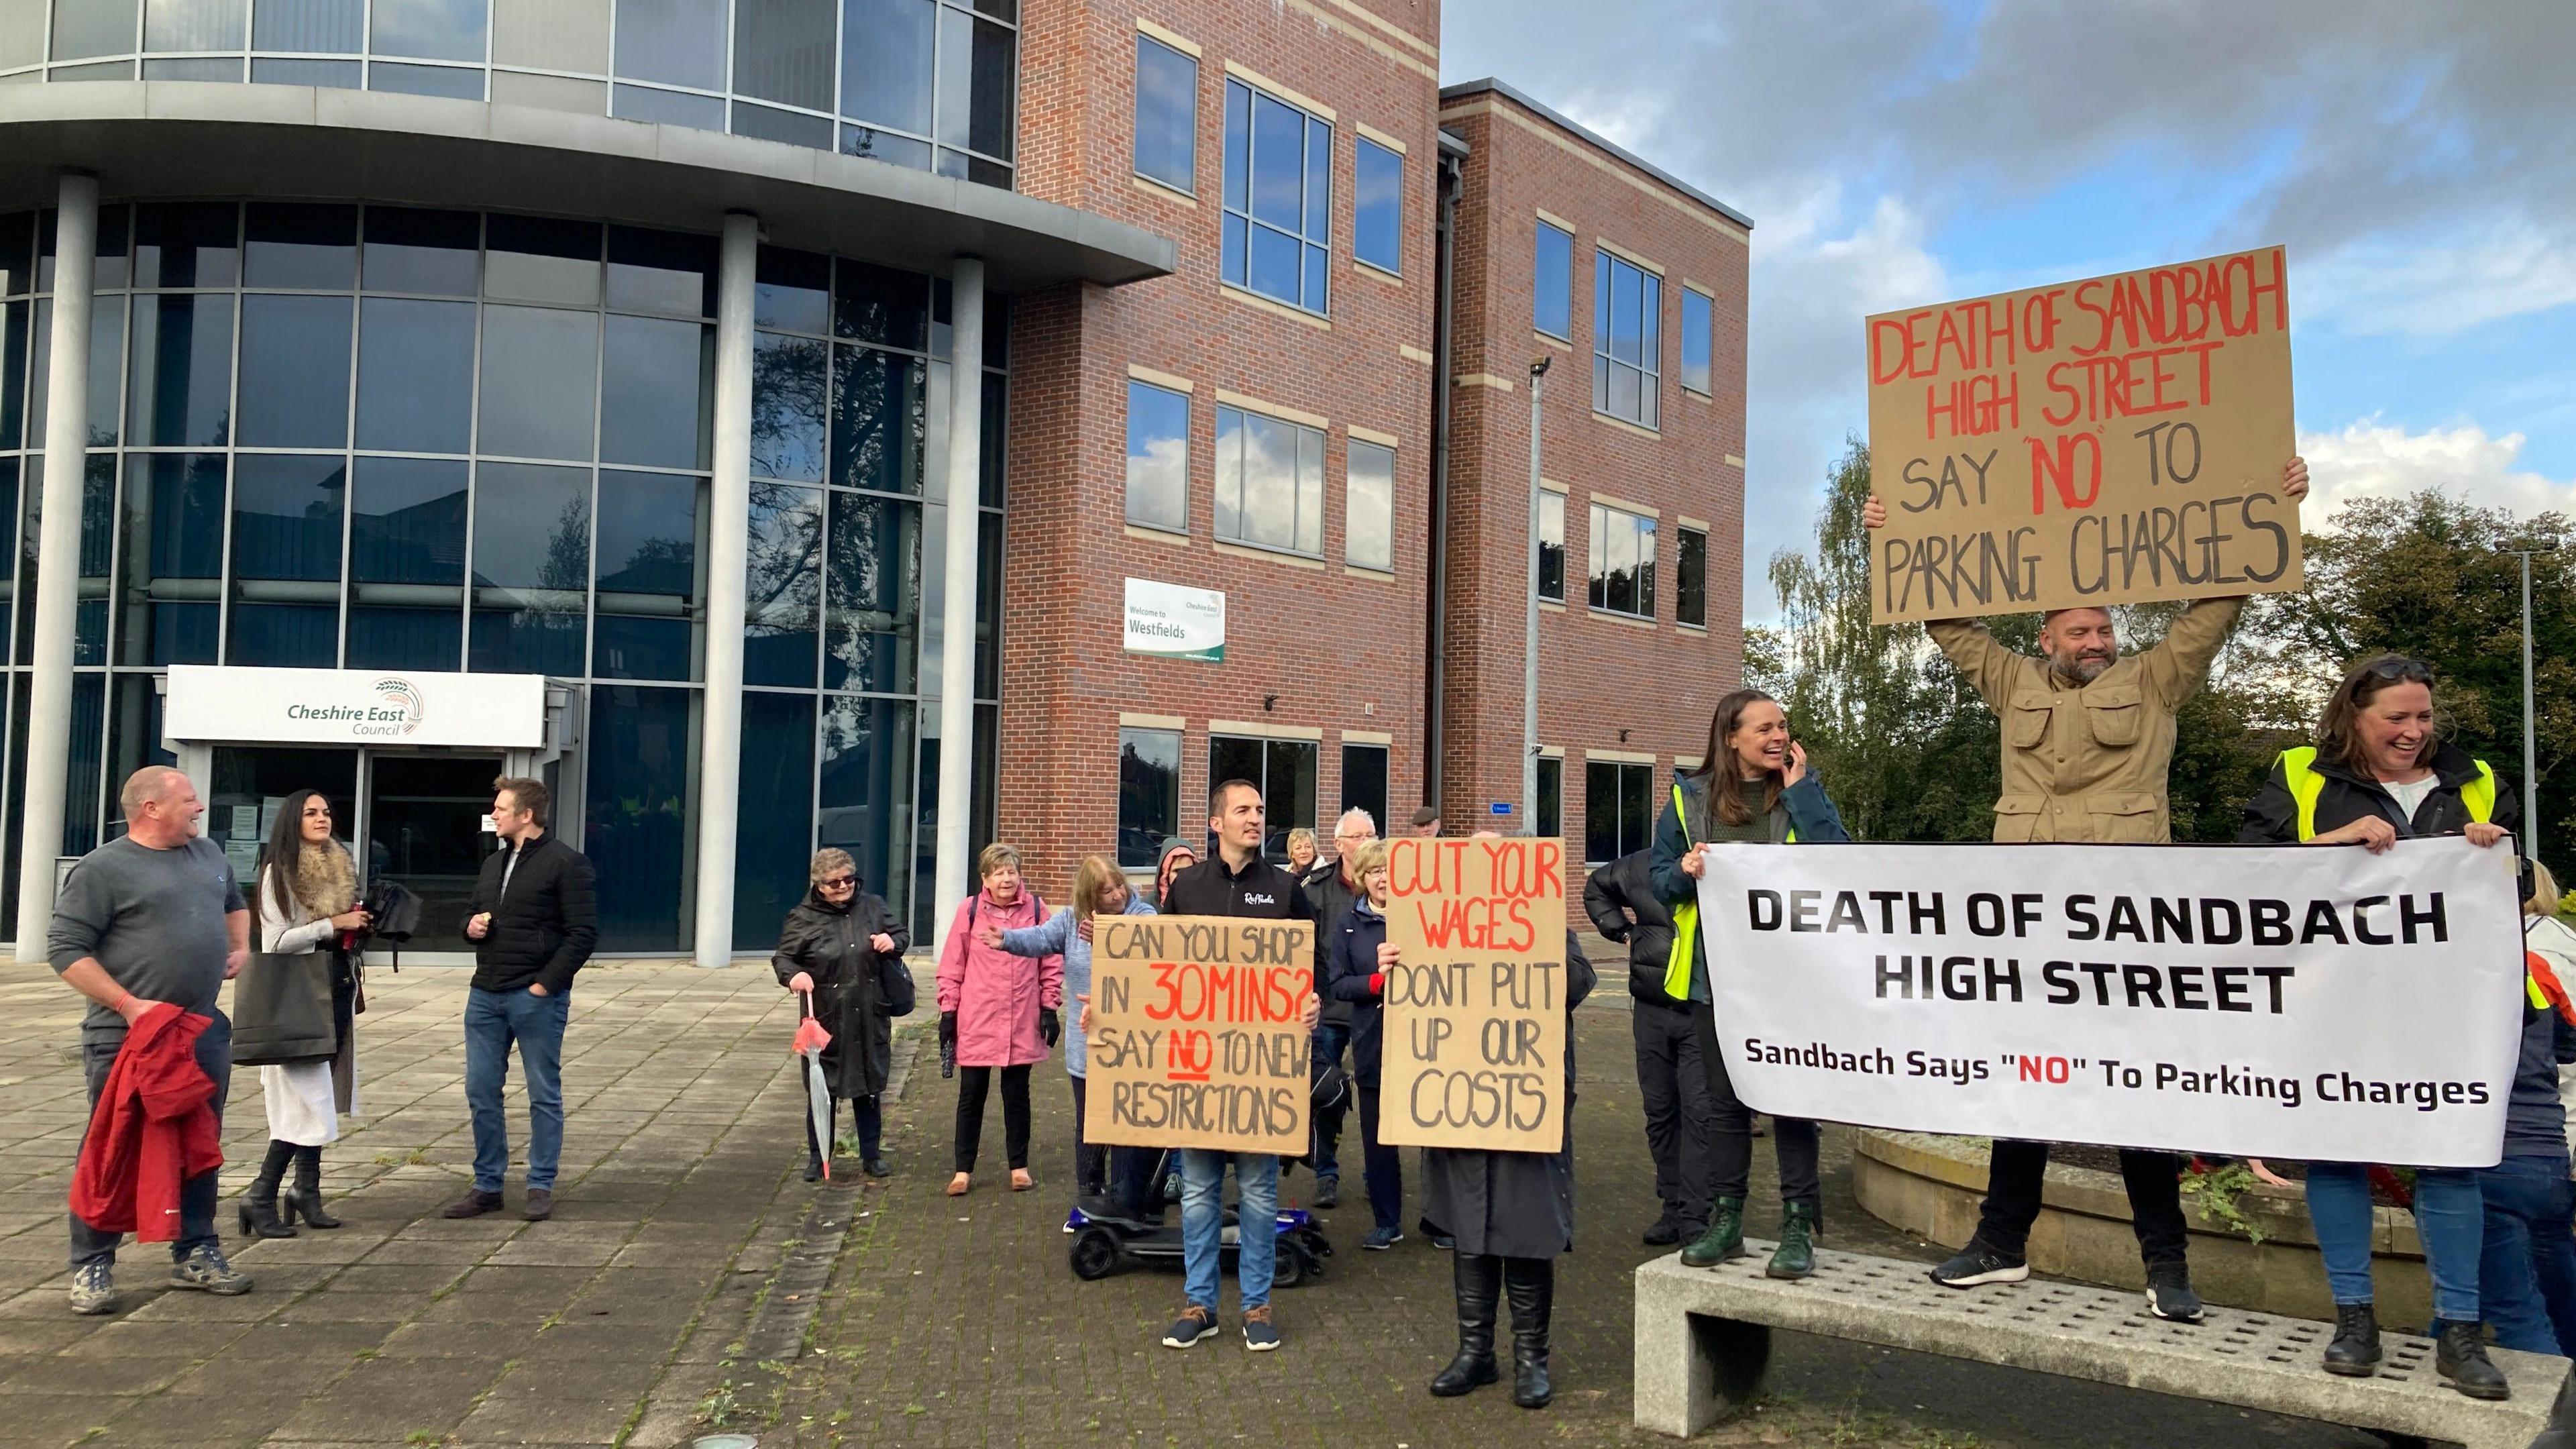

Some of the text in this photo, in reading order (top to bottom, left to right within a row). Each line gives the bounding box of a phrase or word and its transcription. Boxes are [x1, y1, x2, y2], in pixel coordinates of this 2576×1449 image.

[1872, 250, 2286, 385] DEATH OF SANDBACH
[1927, 341, 2224, 440] HIGH STREET
[1900, 448, 1998, 513] SAY
[2134, 421, 2202, 486] TO
[1884, 492, 2290, 613] PARKING CHARGES
[1130, 606, 1166, 618] Welcome to
[1130, 619, 1185, 639] Westfields
[287, 704, 405, 722] Cheshire East
[352, 723, 400, 736] Council
[1390, 840, 1562, 899] CUT YOUR
[1106, 922, 1304, 965] CAN YOU SHOP
[1417, 896, 1536, 952] WAGES
[1747, 889, 2449, 945] DEATH OF SANDBACH
[1101, 976, 1129, 1014] IN
[1491, 961, 1561, 1010] PUT
[1875, 955, 2295, 1015] HIGH STREET
[1096, 1028, 1312, 1078] SAY NO TO NEW
[1411, 1017, 1545, 1068] UP OUR
[1410, 1068, 1547, 1132] COSTS
[1746, 1038, 2489, 1112] Sandbach Says "NO" To Parking Charges
[1113, 1081, 1298, 1136] RESTRICTIONS
